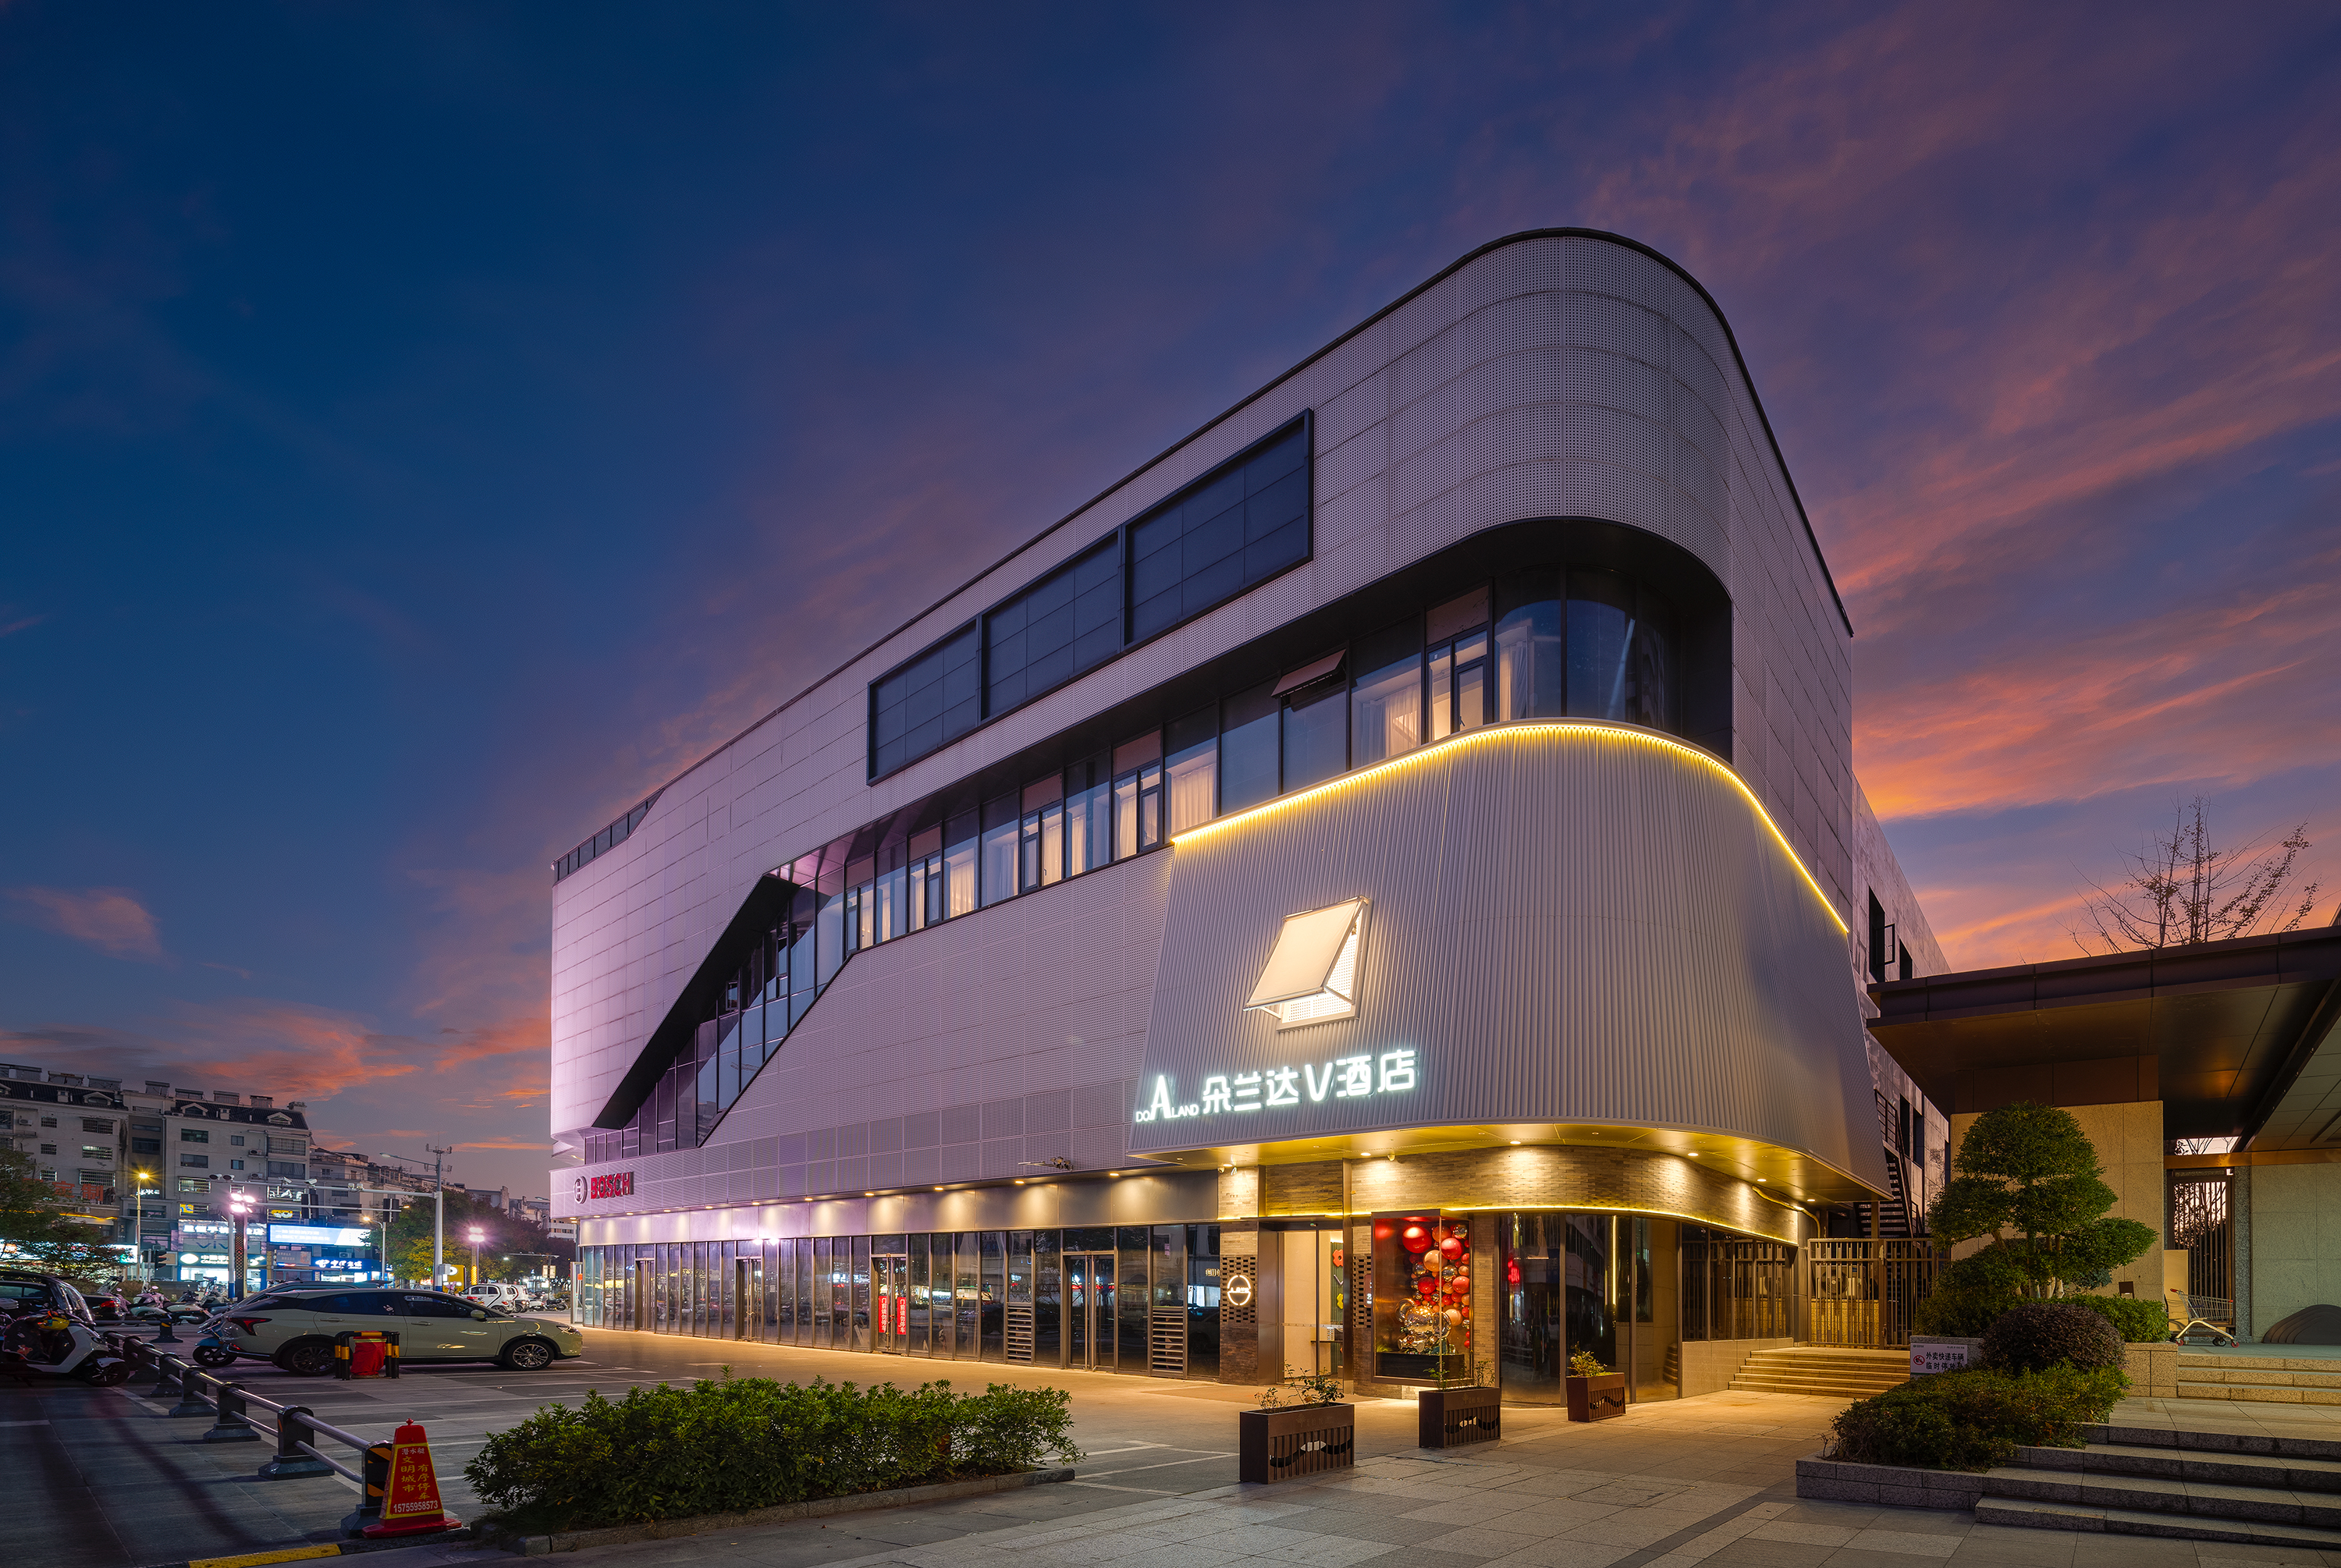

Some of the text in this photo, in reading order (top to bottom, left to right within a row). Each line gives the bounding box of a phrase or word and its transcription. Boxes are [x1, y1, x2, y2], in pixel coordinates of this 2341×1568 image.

[1202, 1049, 1416, 1114] 朵兰达V酒店
[591, 1172, 633, 1199] BOSCH
[1926, 1351, 1964, 1361] 外卖快递车辆
[400, 1456, 416, 1492] 文明城市
[417, 1464, 431, 1499] 有序停车
[393, 1500, 439, 1513] 15755958573
